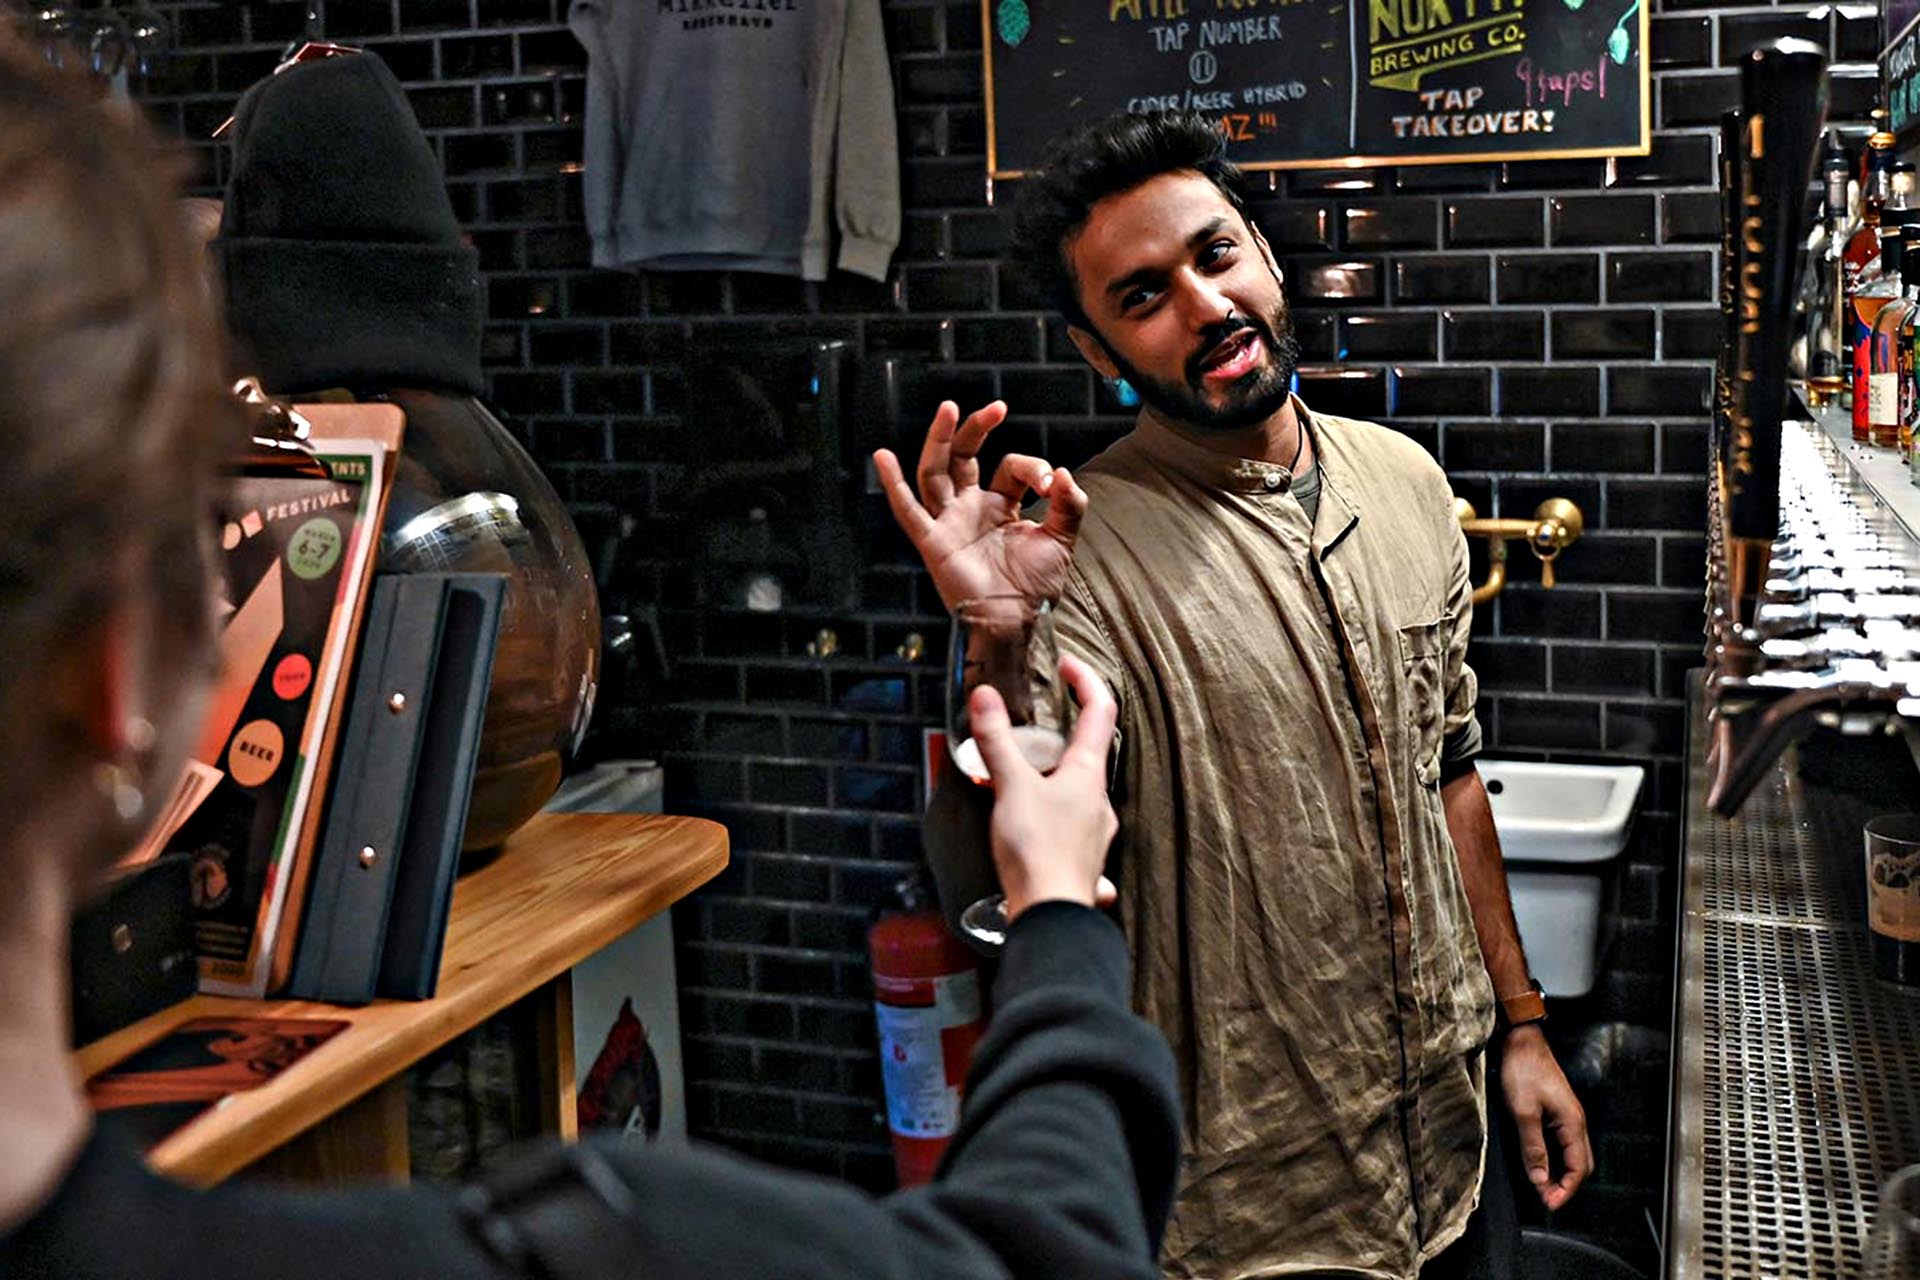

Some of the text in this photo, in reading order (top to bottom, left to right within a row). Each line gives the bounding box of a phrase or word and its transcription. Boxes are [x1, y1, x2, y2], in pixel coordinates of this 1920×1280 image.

[1149, 15, 1282, 51] TAP NUMBER
[1370, 24, 1526, 76] BREWING CO.
[1420, 86, 1485, 110] TAP
[1392, 110, 1556, 138] TAKEOVER!
[267, 488, 351, 521] FESTIVAL
[240, 740, 275, 762] BEER
